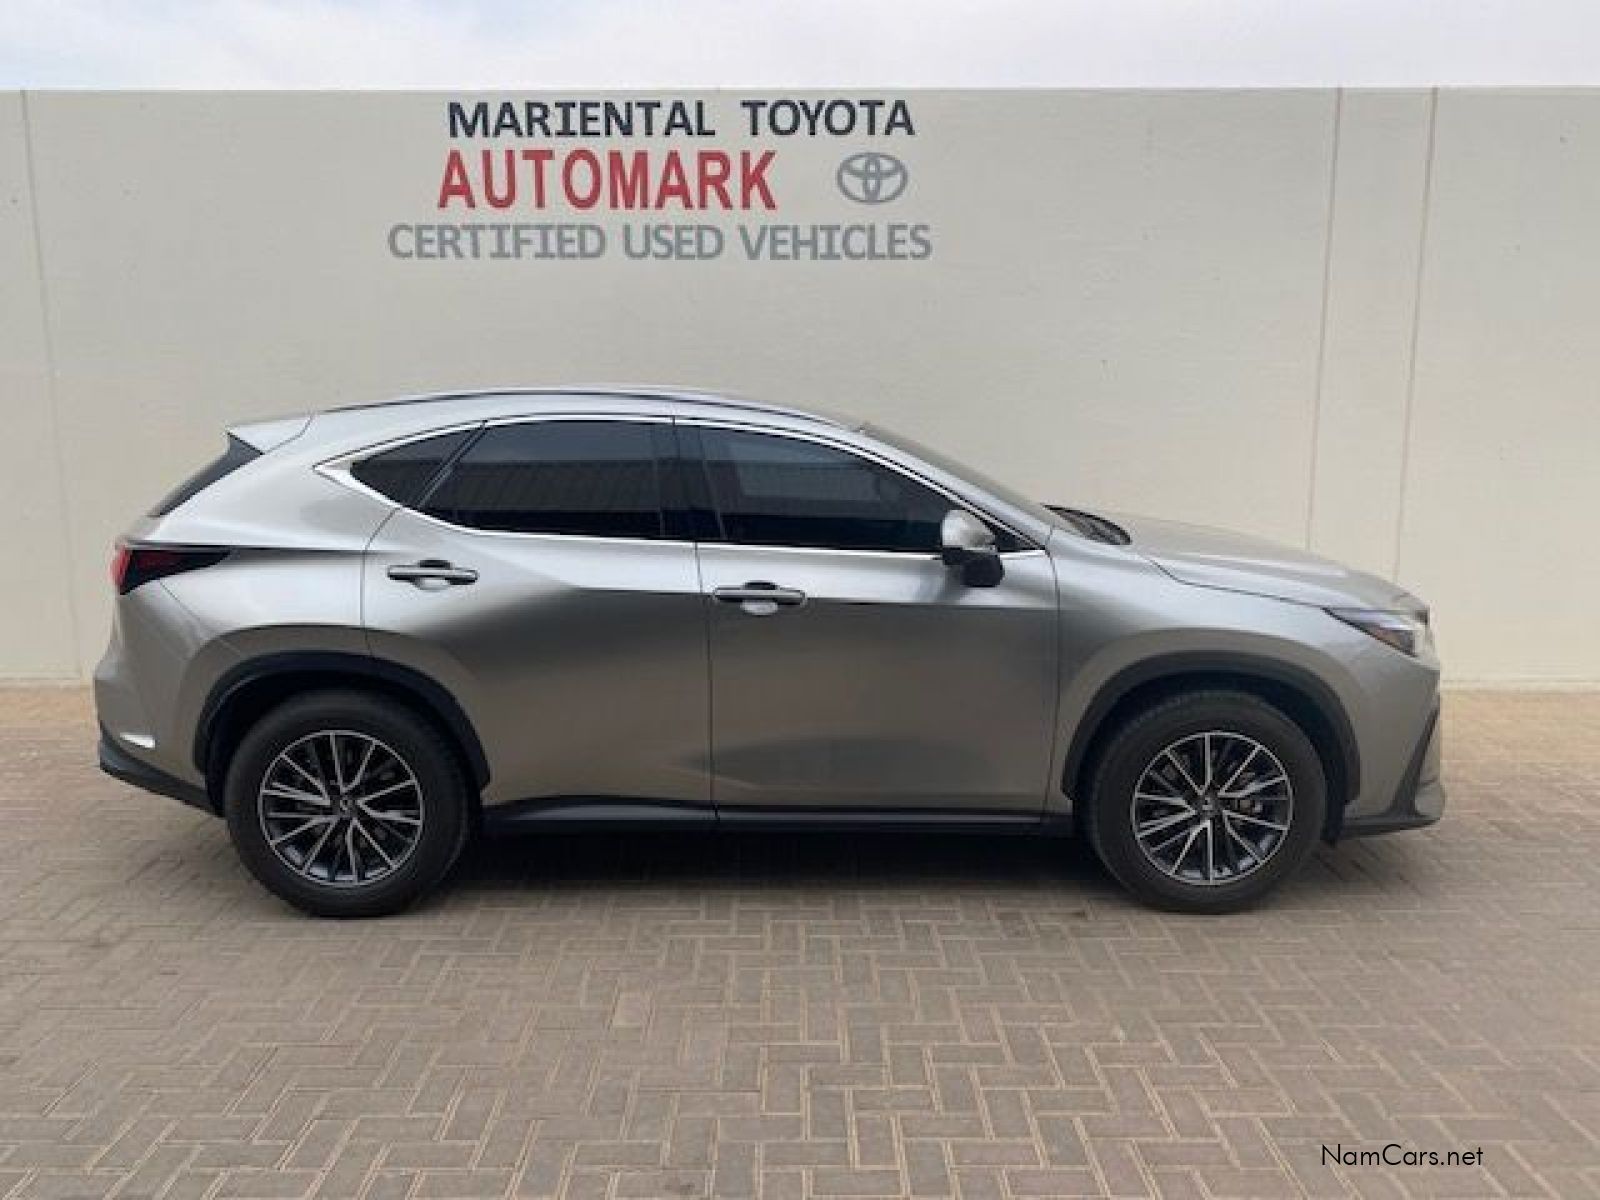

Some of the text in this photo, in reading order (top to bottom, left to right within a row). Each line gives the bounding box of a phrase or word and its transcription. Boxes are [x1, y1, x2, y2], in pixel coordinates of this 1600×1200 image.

[448, 99, 916, 138] MARIENTAL TOYOTA
[437, 149, 778, 211] AUTOMARK
[387, 223, 933, 261] CERTIFIED USED VEHICLES
